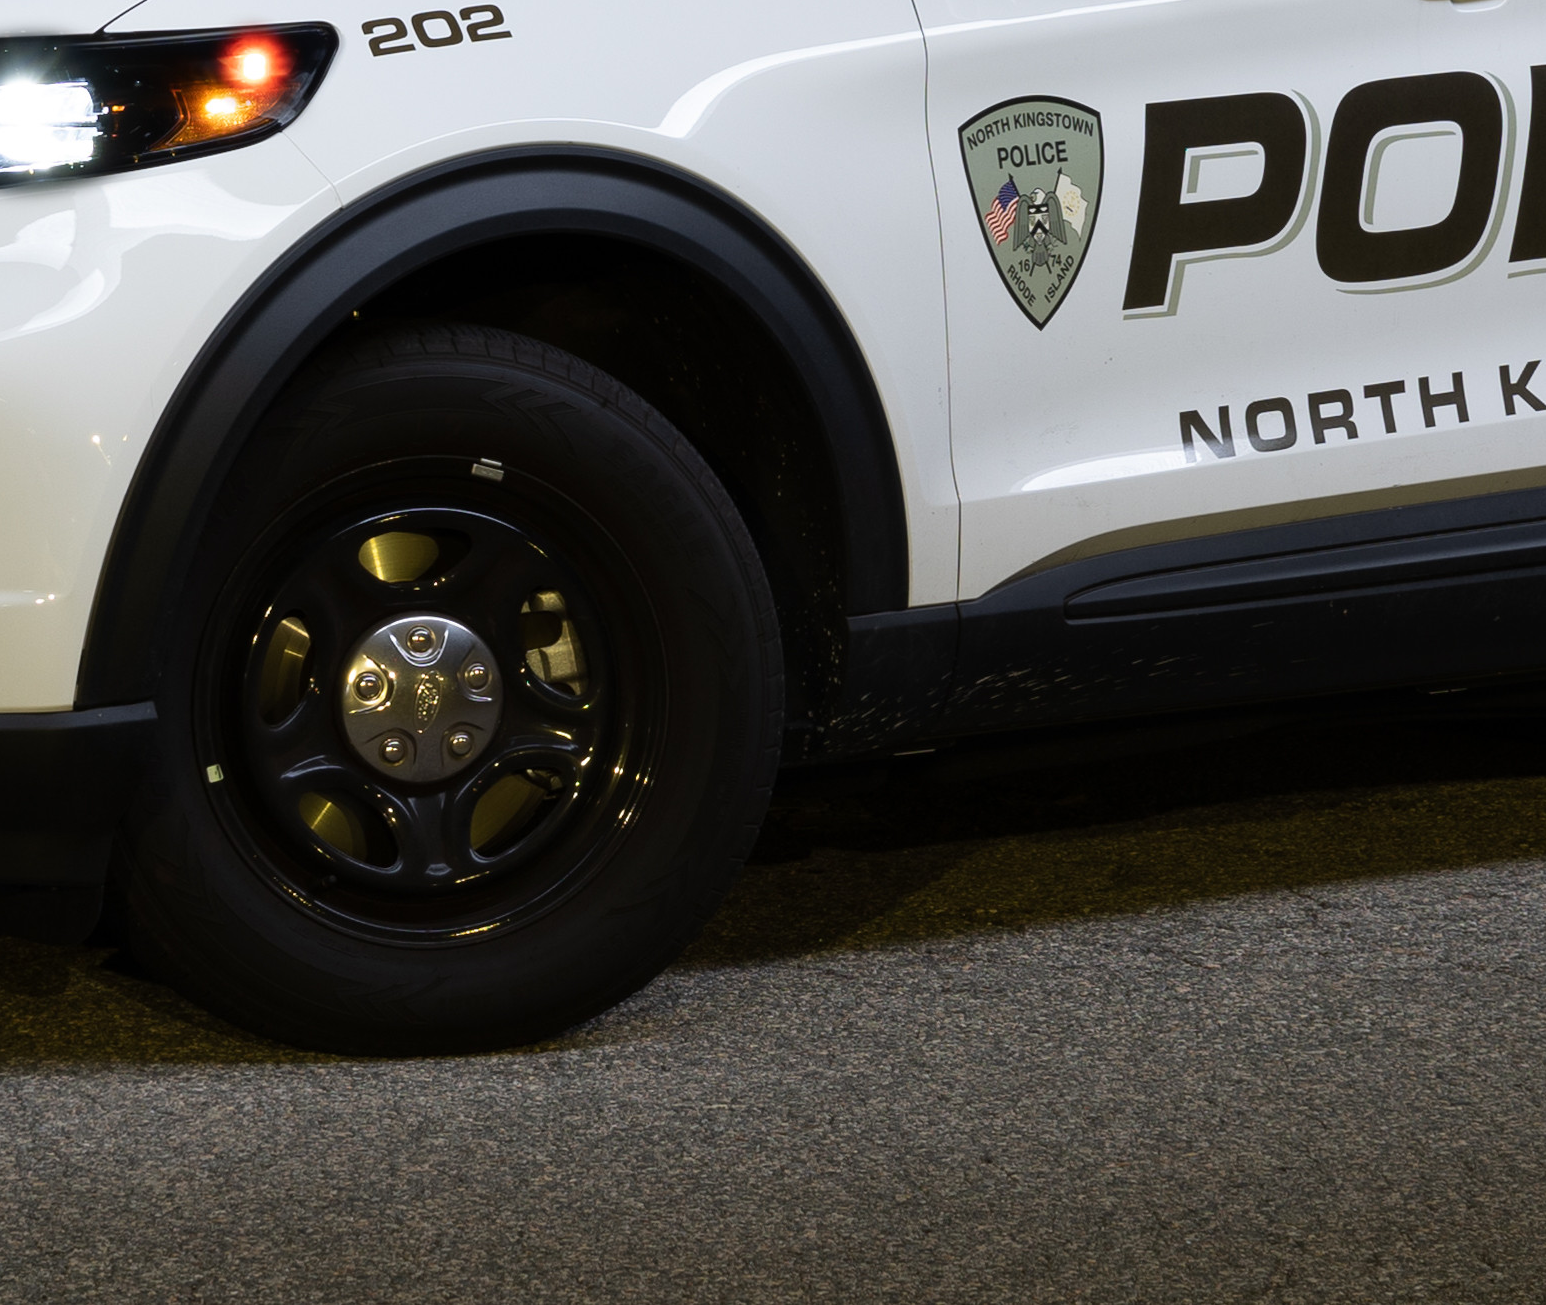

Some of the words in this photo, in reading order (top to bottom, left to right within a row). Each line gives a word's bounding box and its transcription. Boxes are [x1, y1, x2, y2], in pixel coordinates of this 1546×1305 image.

[362, 4, 512, 57] 202
[967, 116, 1011, 151] NORTH
[1013, 111, 1094, 137] KINGSTOWN
[997, 140, 1069, 169] POLICE
[1007, 264, 1037, 307] RHODE
[1044, 255, 1075, 303] ISLAND
[1018, 259, 1031, 273] 16
[1049, 254, 1062, 268] 74
[1178, 371, 1466, 464] NORTH
